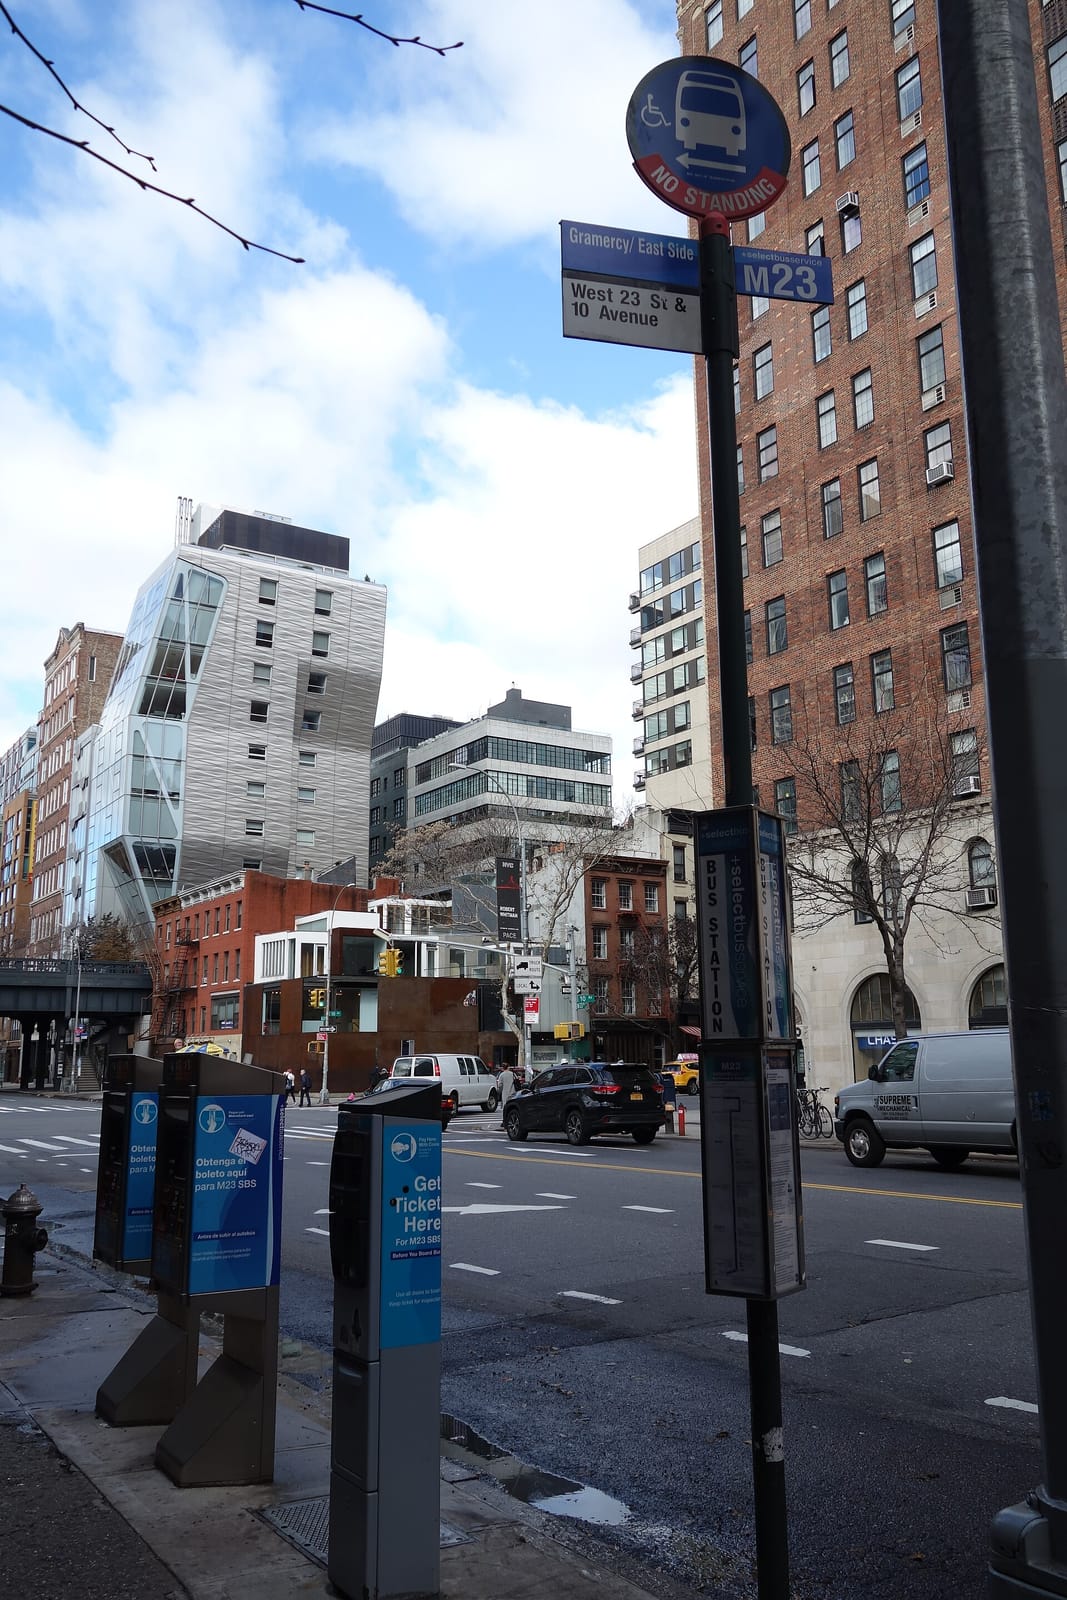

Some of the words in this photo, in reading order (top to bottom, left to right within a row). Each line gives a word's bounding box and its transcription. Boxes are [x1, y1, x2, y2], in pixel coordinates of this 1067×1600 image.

[650, 165, 679, 193] NO
[684, 178, 777, 212] STANDING
[569, 227, 635, 254] Gramercy/
[638, 238, 664, 257] East
[667, 242, 694, 261] Side
[743, 263, 818, 299] M23
[571, 282, 613, 303] West
[620, 289, 640, 306] 23
[650, 294, 668, 310] St
[674, 297, 687, 313] &
[571, 301, 589, 318] 10
[599, 305, 658, 327] Avenue
[502, 861, 514, 869] NYC
[707, 860, 717, 906] BUS
[709, 918, 722, 1033] STATION
[763, 917, 773, 1032] STATION
[879, 1095, 911, 1105] SUPREME
[130, 1155, 156, 1164] boleto
[195, 1158, 236, 1167] Obtenga
[129, 1166, 148, 1175] para
[195, 1170, 225, 1179] boleto
[226, 1167, 248, 1179] aquí
[194, 1183, 215, 1193] para
[216, 1181, 236, 1190] M23
[237, 1179, 257, 1189] SBS
[414, 1175, 441, 1192] Get
[395, 1196, 441, 1214] Ticket
[404, 1216, 441, 1233] Here
[395, 1238, 408, 1246] For
[409, 1236, 426, 1245] M23
